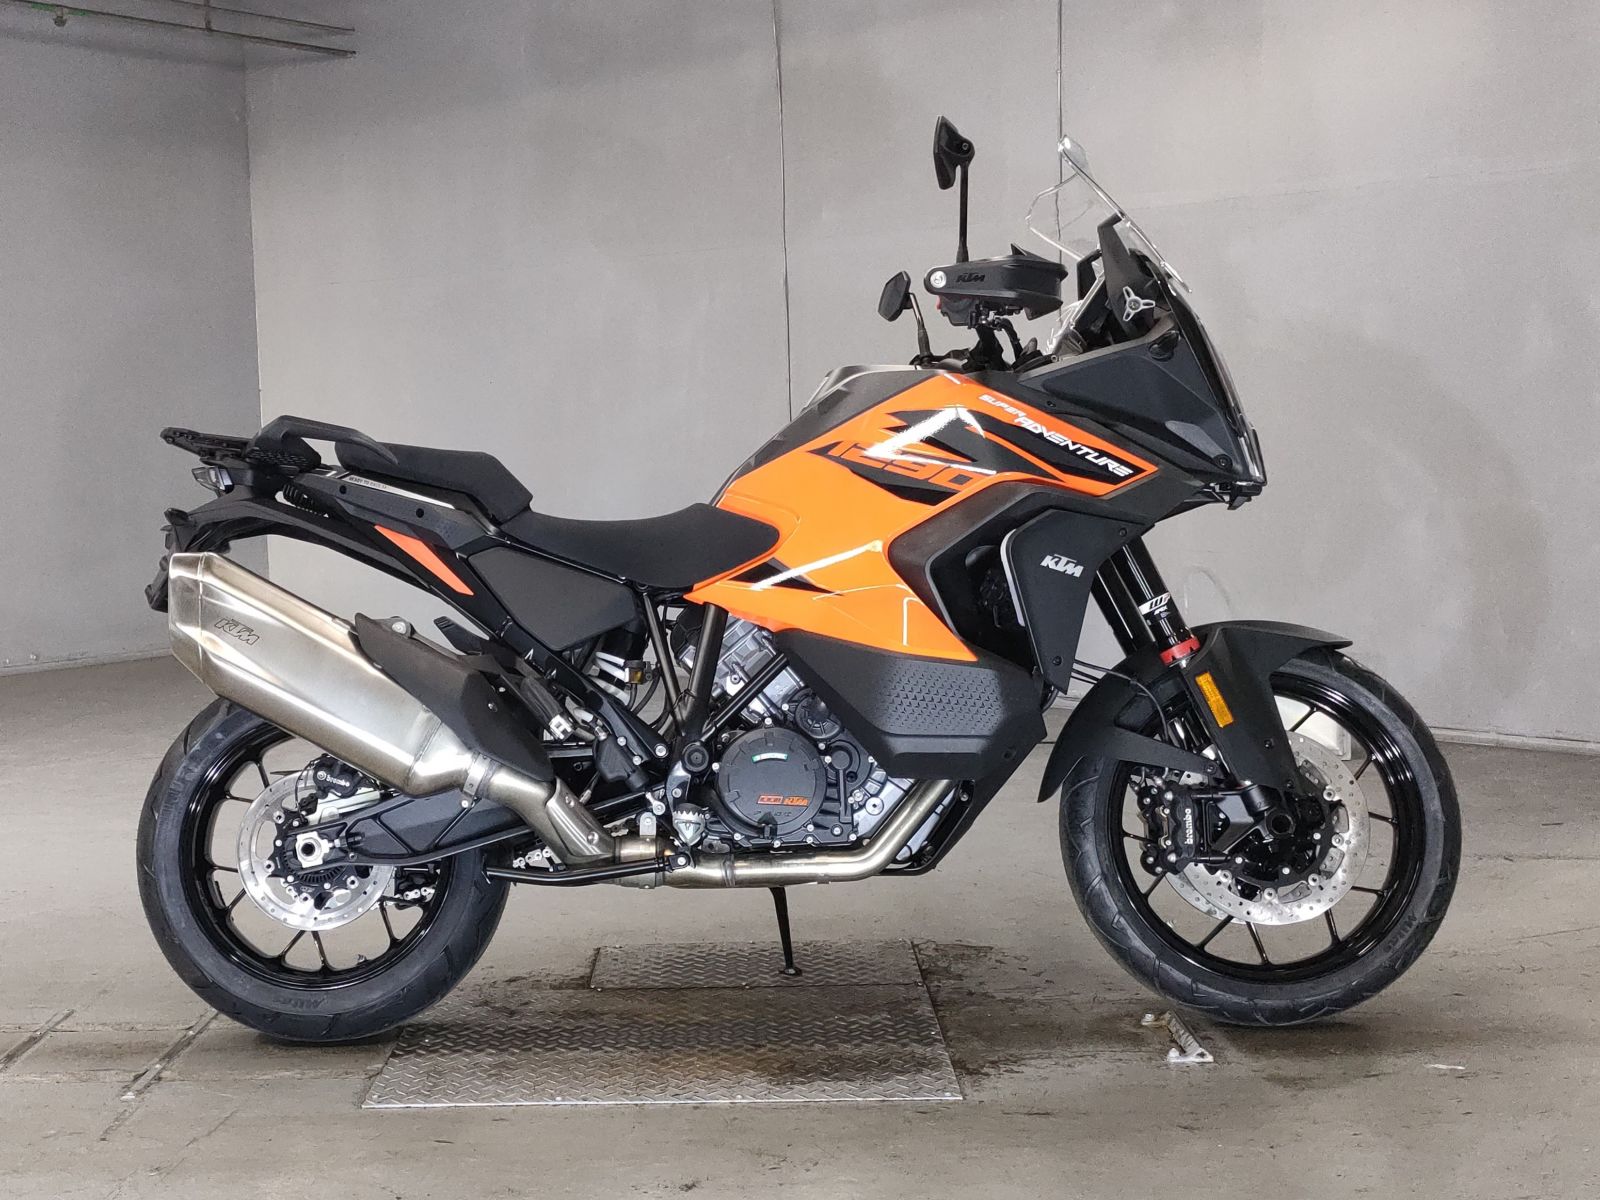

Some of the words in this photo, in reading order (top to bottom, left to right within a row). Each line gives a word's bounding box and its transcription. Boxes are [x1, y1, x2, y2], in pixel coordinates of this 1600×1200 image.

[956, 272, 985, 283] KTM
[978, 394, 1027, 417] SUPER
[1014, 416, 1134, 477] ADVENTURE
[1040, 553, 1084, 578] KTM
[214, 618, 260, 646] KTM
[326, 774, 350, 787] brembo
[1184, 808, 1193, 845] brembo
